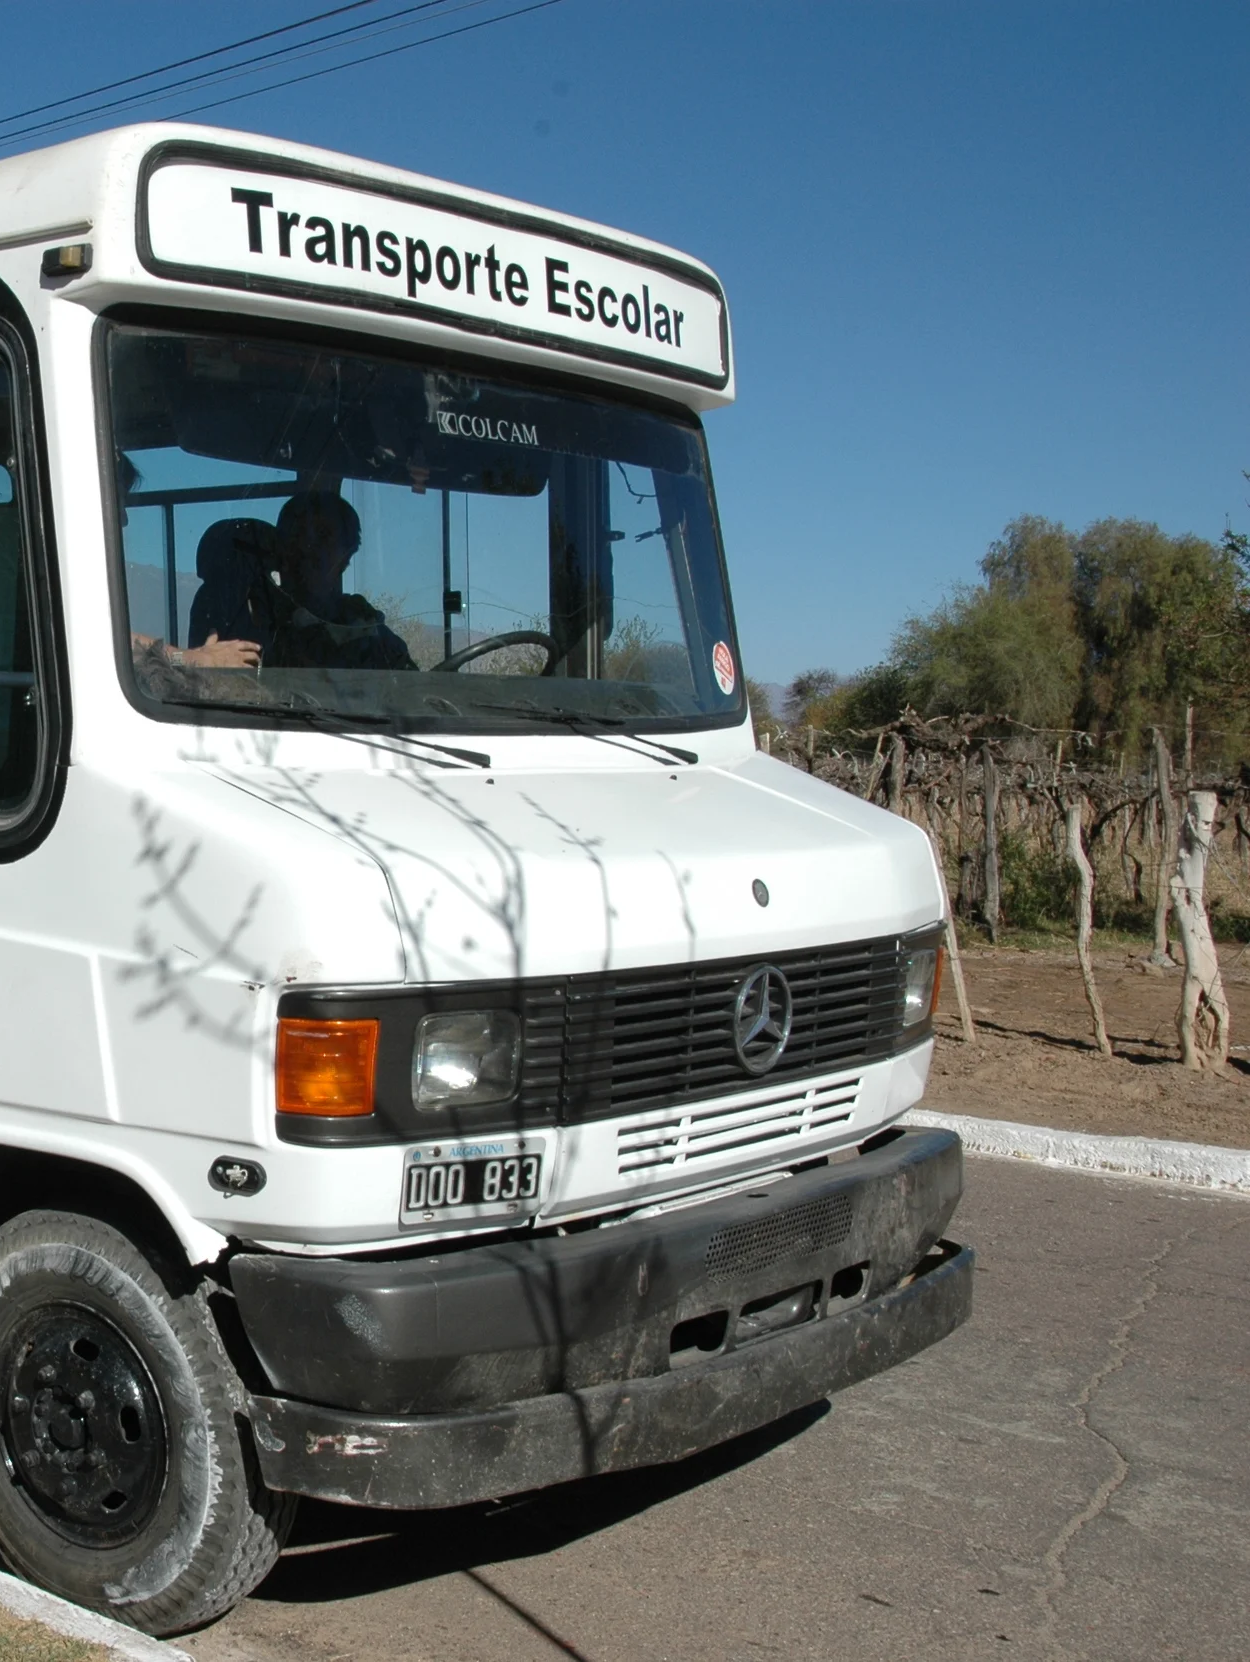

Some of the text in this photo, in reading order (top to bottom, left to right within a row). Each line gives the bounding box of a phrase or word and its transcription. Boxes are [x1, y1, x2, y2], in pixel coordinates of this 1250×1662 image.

[231, 187, 684, 348] Transporte Escolar
[450, 1143, 504, 1157] ARGENTINA
[483, 1157, 538, 1201] 833
